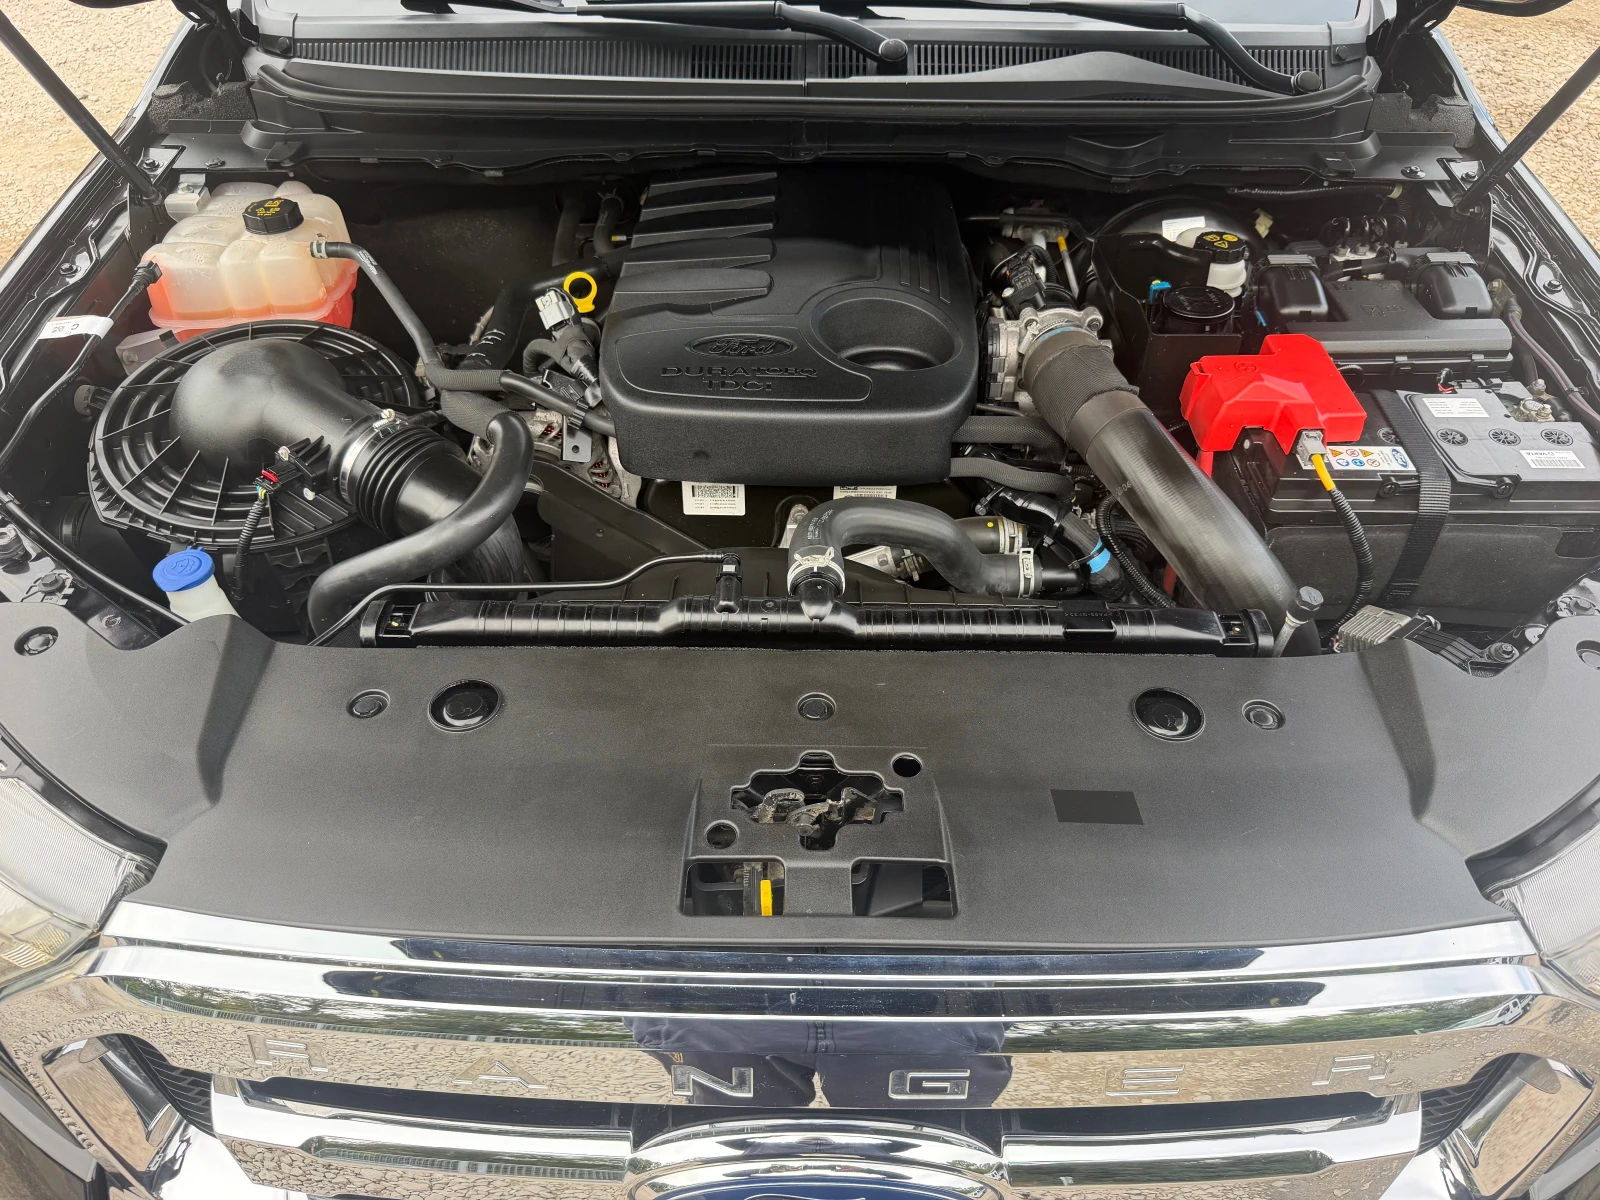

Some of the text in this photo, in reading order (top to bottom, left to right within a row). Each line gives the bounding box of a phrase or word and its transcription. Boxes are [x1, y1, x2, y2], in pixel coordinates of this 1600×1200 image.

[708, 338, 776, 355] Ford
[661, 366, 817, 378] DURATORQ
[247, 1034, 1392, 1099] RANGER
